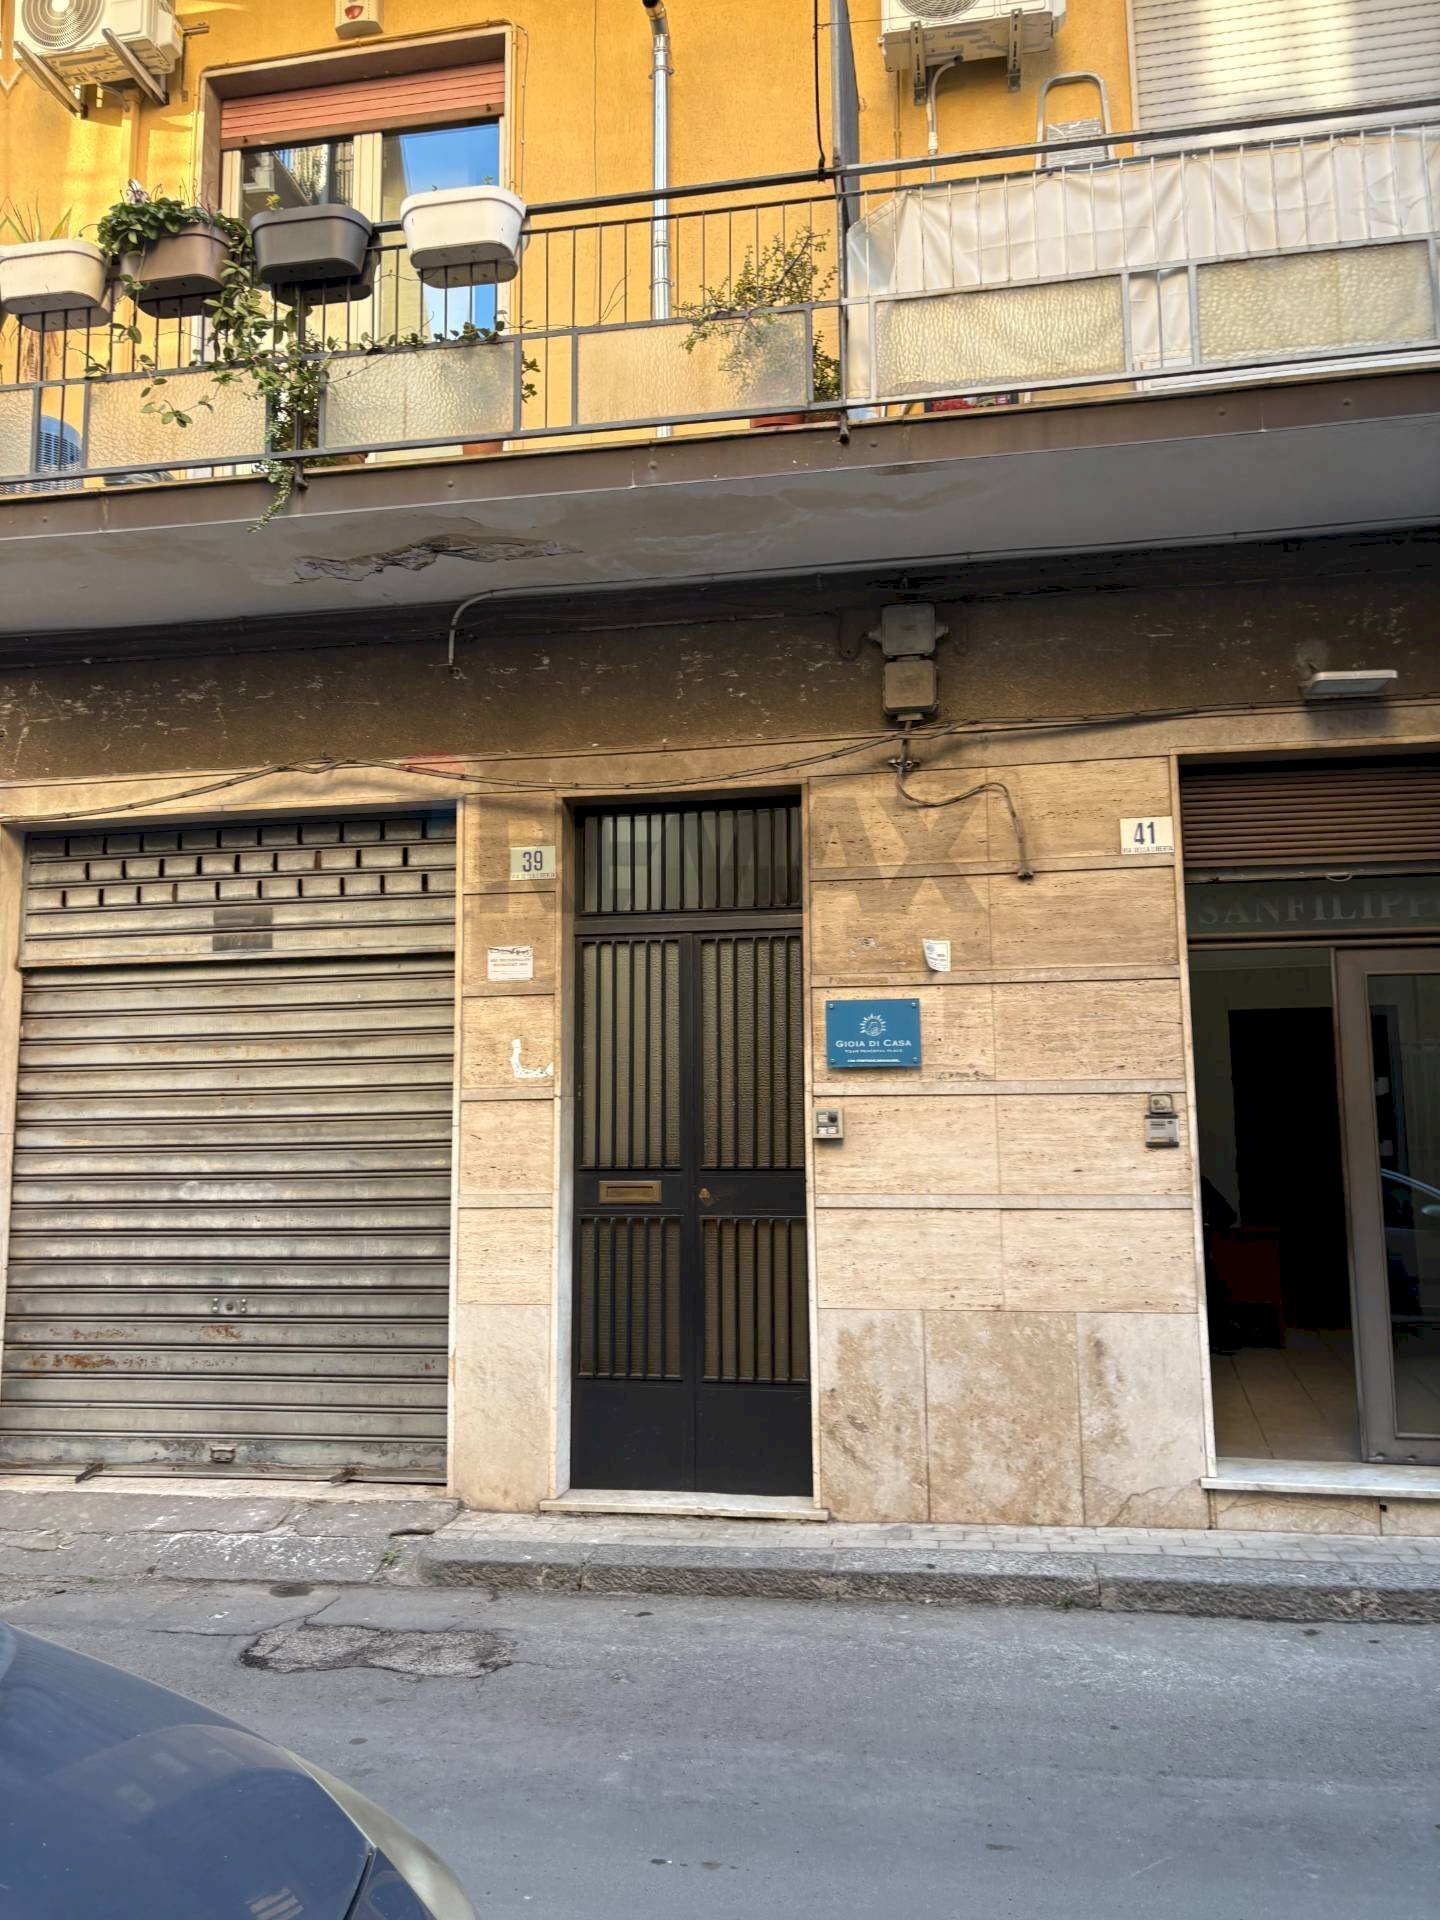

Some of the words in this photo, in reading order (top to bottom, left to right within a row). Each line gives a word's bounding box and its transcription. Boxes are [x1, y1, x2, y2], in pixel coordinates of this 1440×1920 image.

[1133, 822, 1155, 845] 41
[522, 850, 543, 872] 39
[835, 1040, 866, 1048] GIOIA
[882, 1039, 912, 1047] CASA
